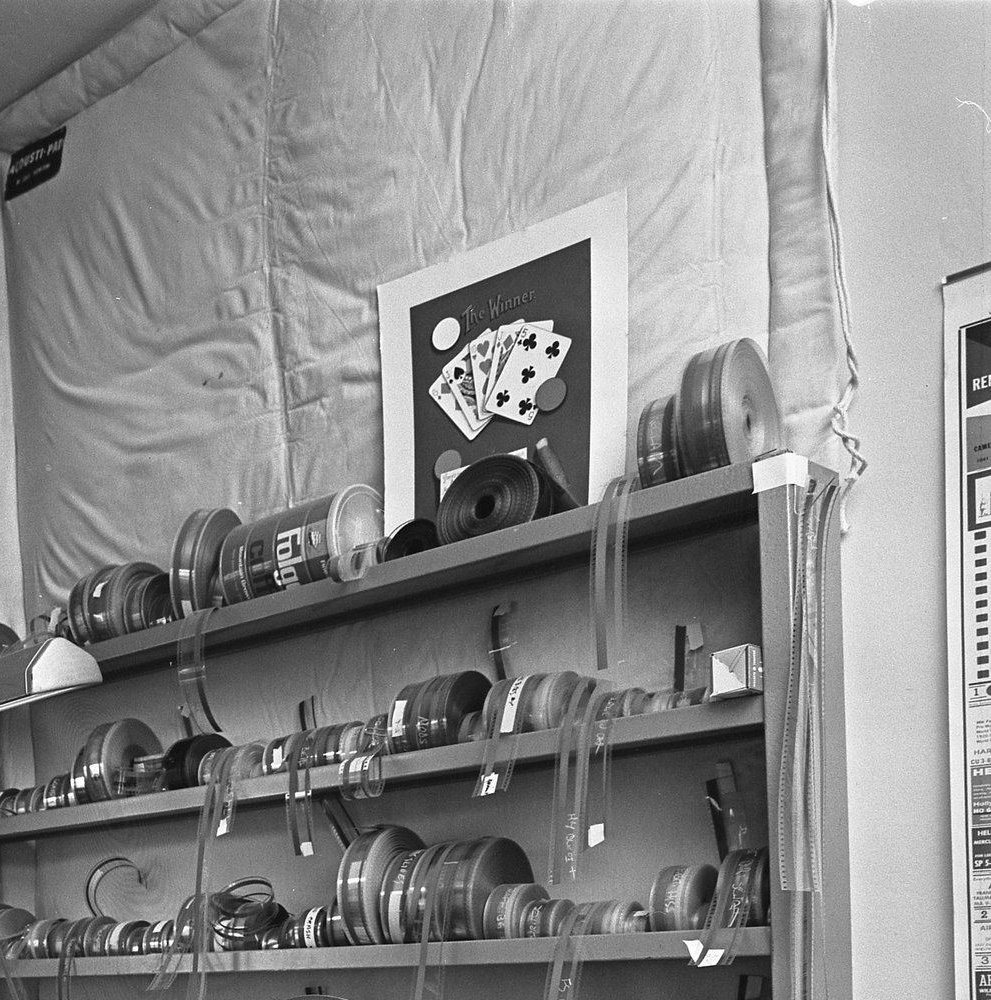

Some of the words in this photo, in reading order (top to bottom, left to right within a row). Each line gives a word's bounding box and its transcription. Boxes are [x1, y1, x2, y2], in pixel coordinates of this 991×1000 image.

[462, 304, 486, 333] The
[974, 688, 979, 696] 1
[980, 910, 988, 919] 2
[981, 956, 989, 965] 3
